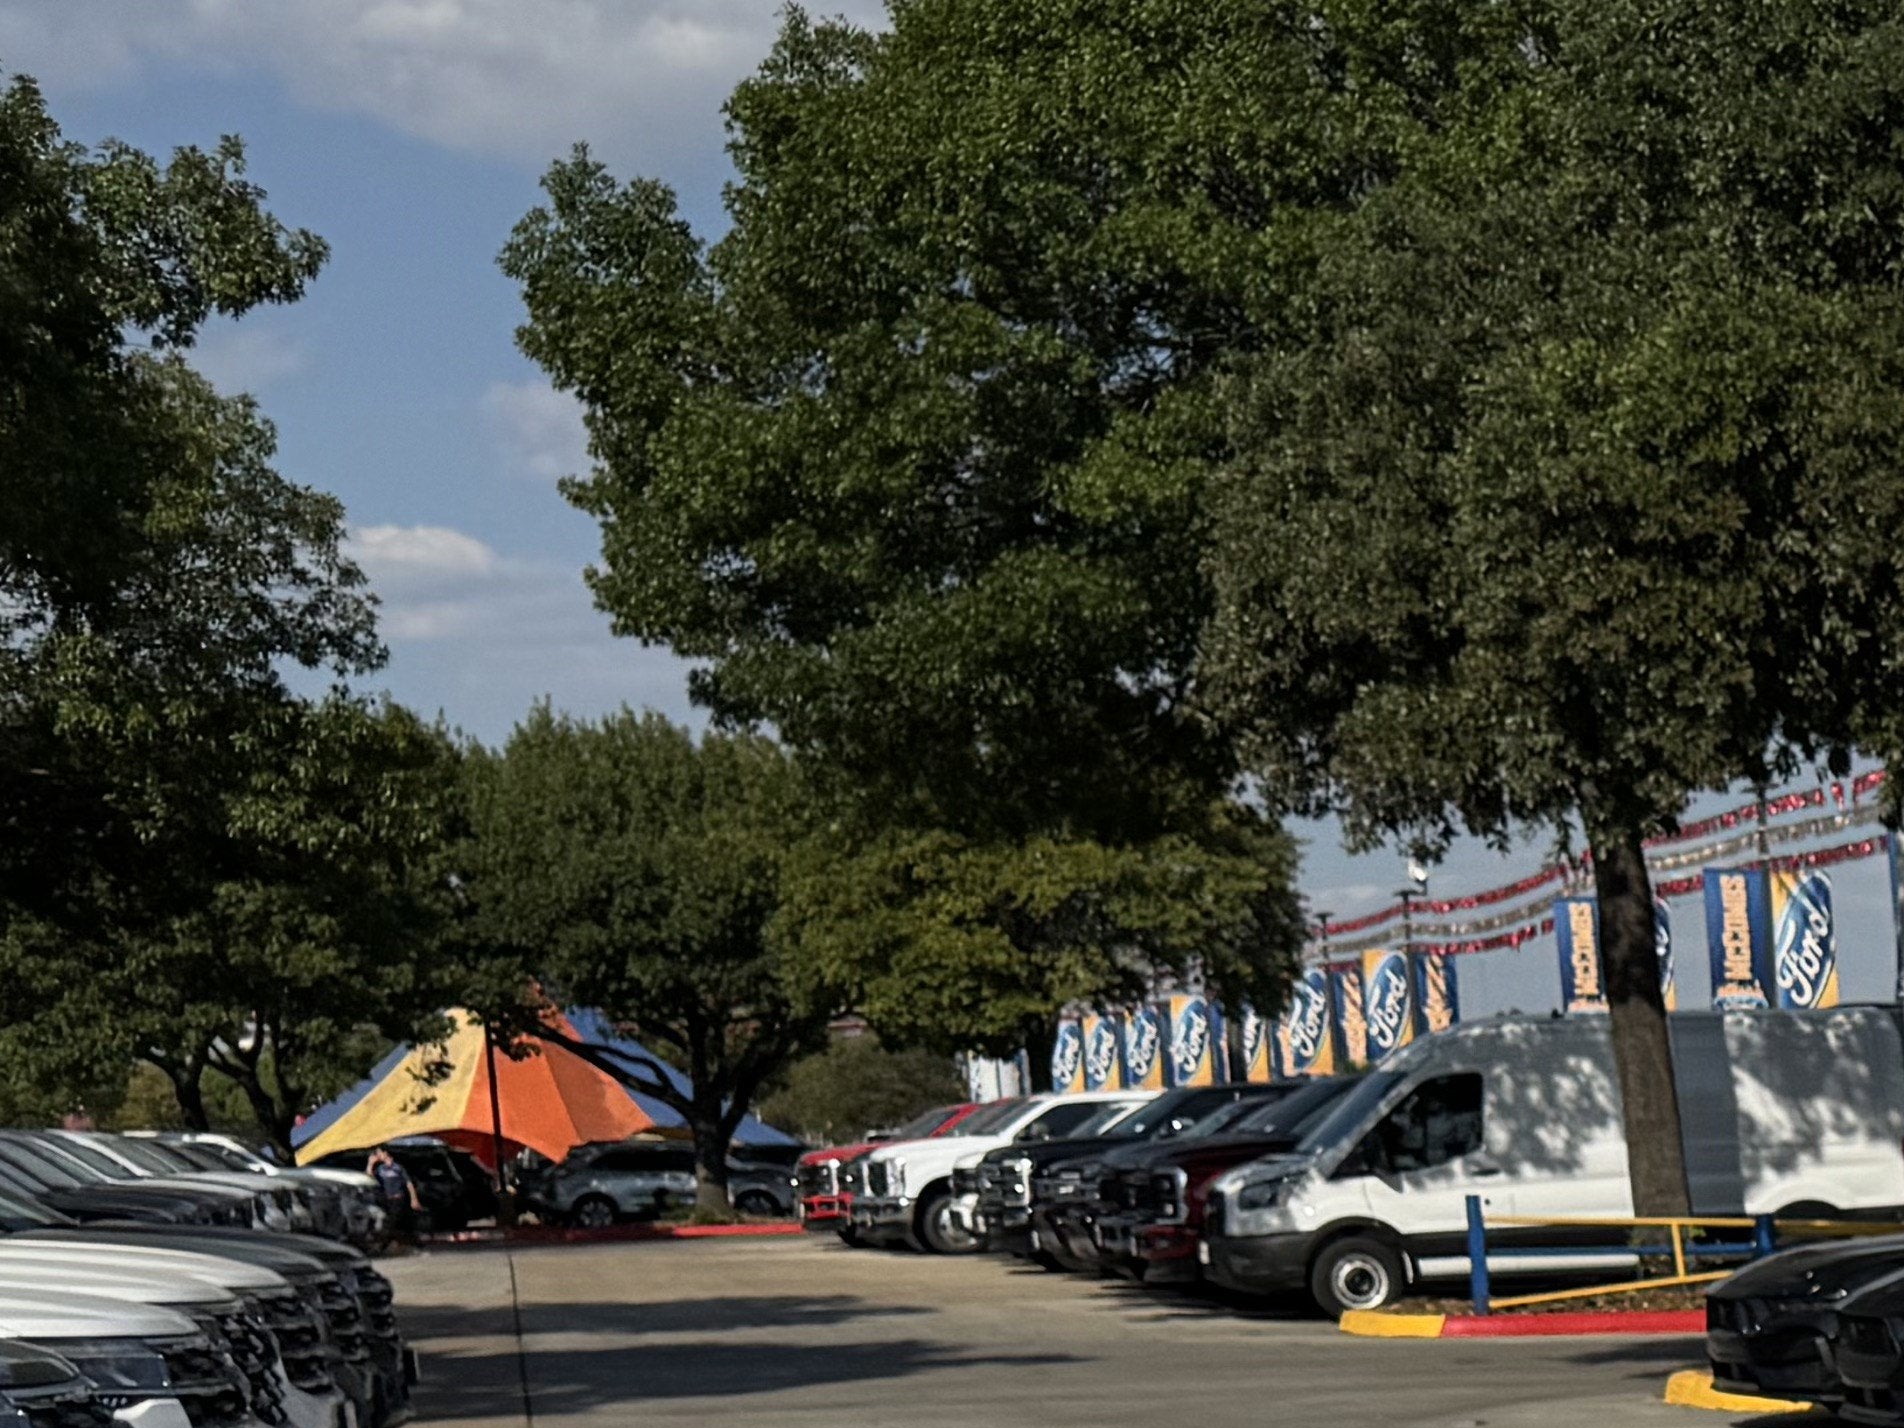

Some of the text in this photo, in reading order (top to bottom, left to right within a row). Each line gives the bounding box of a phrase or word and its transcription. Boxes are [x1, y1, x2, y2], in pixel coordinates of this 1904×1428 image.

[1775, 890, 1830, 1007] Ford
[1171, 1009, 1207, 1074] Ford
[1290, 979, 1327, 1058] Ford
[1369, 967, 1408, 1049] Ford
